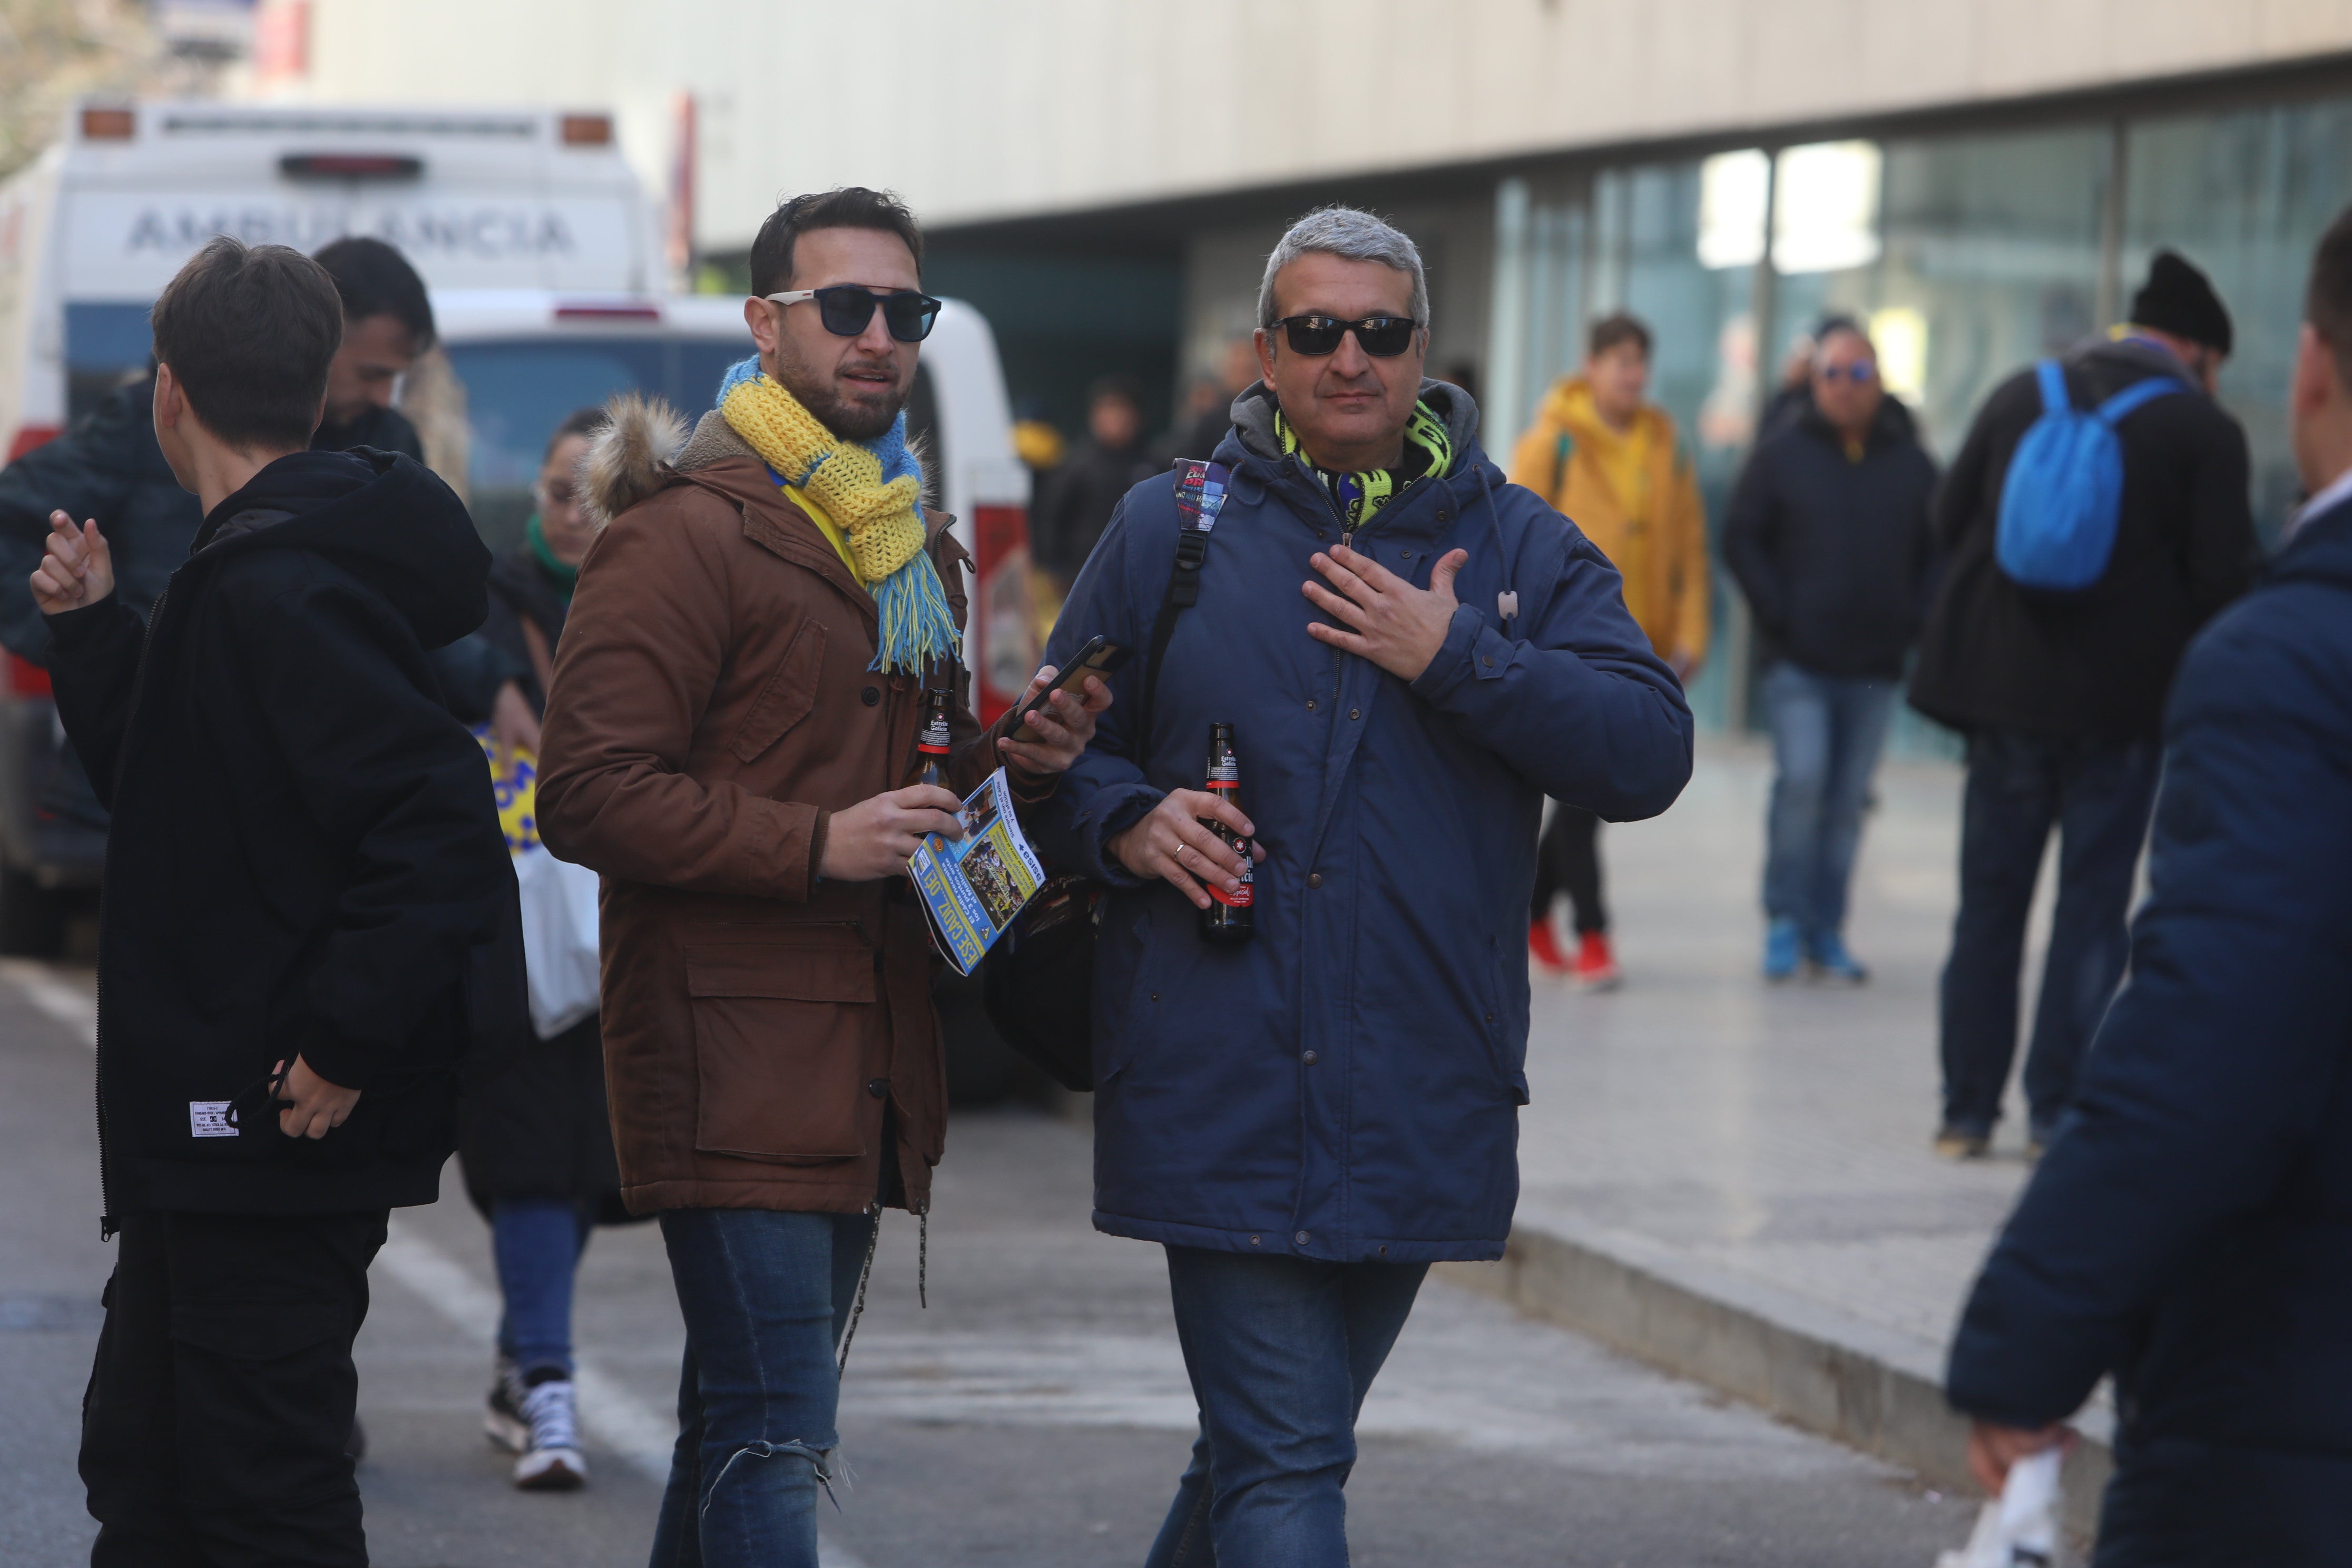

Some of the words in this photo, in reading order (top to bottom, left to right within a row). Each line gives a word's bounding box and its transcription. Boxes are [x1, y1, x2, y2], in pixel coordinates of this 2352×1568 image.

[997, 822, 1008, 842] mercado
[1004, 814, 1015, 838] Siempre
[944, 857, 955, 875] ante
[1020, 865, 1031, 881] martes
[940, 862, 958, 894] necesita
[953, 863, 973, 896] Mallorca
[954, 875, 971, 903] puntos
[969, 895, 977, 904] el
[956, 893, 971, 915] Cádiz
[968, 915, 975, 924] El
[971, 908, 981, 922] los
[956, 933, 979, 968] ¡ESE
